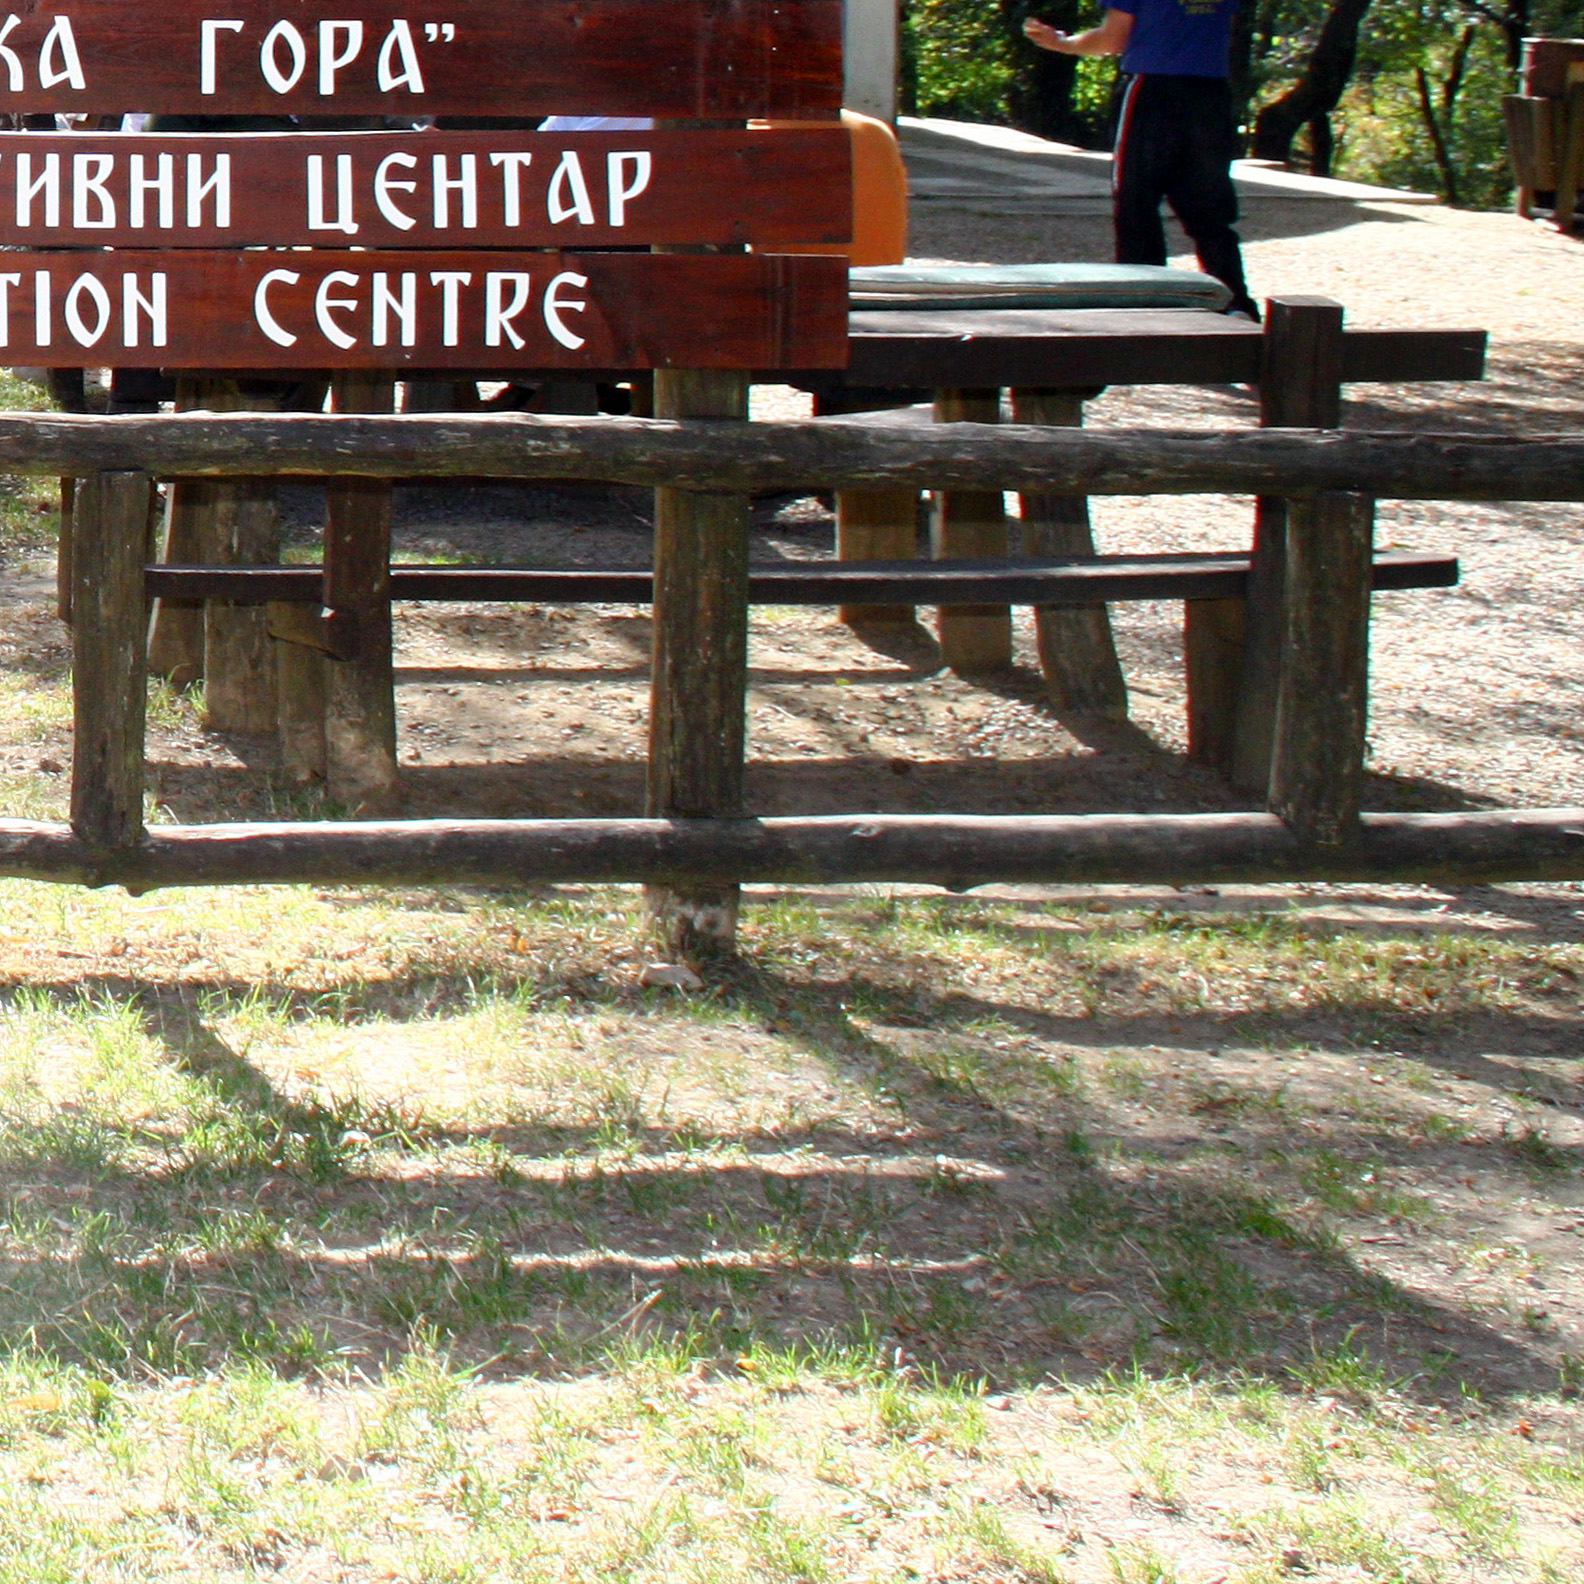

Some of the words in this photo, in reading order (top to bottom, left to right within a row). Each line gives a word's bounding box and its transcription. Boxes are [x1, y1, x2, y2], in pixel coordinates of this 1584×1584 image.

[200, 19, 455, 95] ГОРА”
[307, 150, 651, 235] ЦЕНТАР
[254, 269, 588, 350] CENTRE
